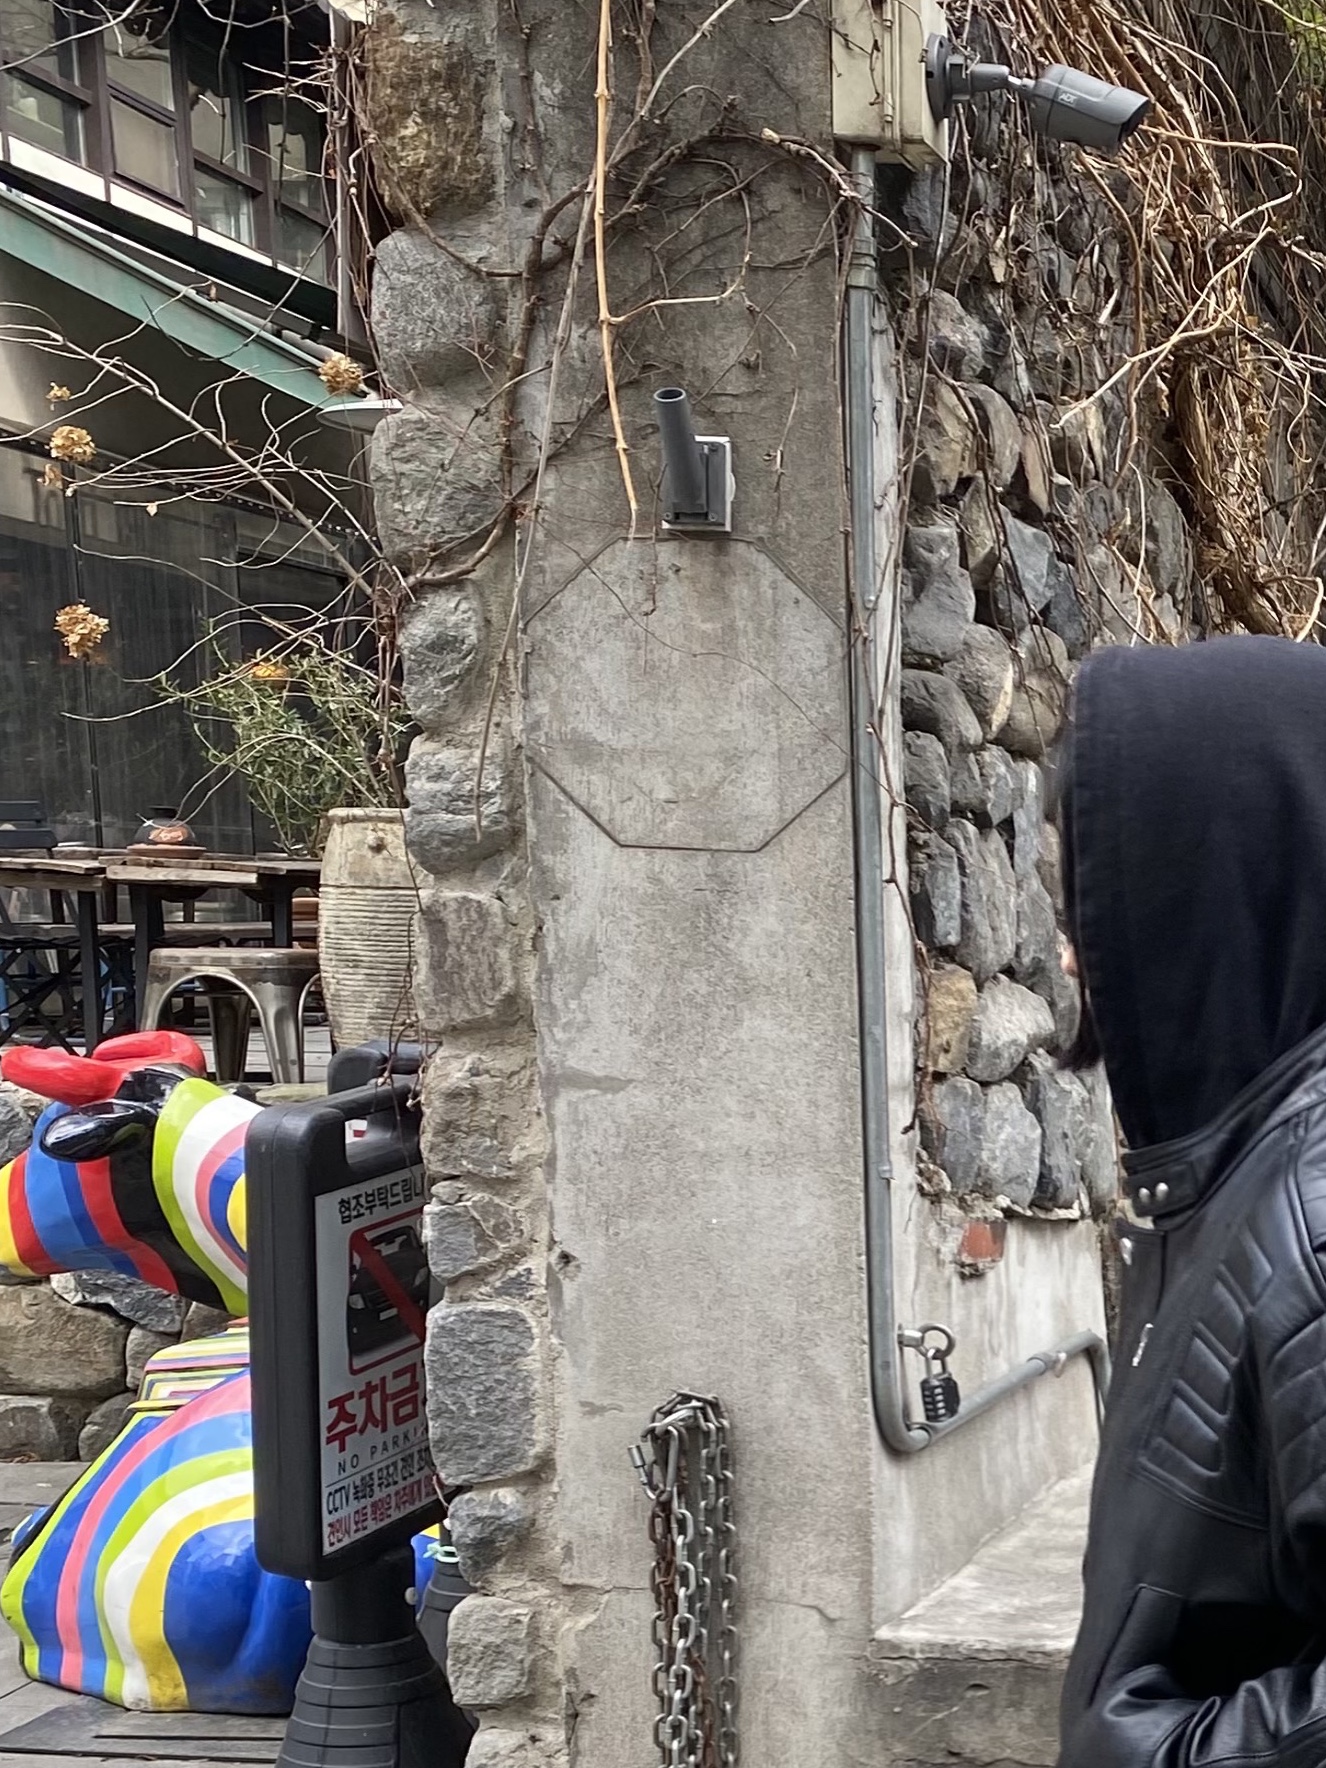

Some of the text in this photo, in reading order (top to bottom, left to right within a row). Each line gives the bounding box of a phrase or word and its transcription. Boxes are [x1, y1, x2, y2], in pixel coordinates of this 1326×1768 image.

[325, 1361, 427, 1454] 주차금
[338, 1453, 359, 1476] NO
[326, 1483, 351, 1515] CCTV
